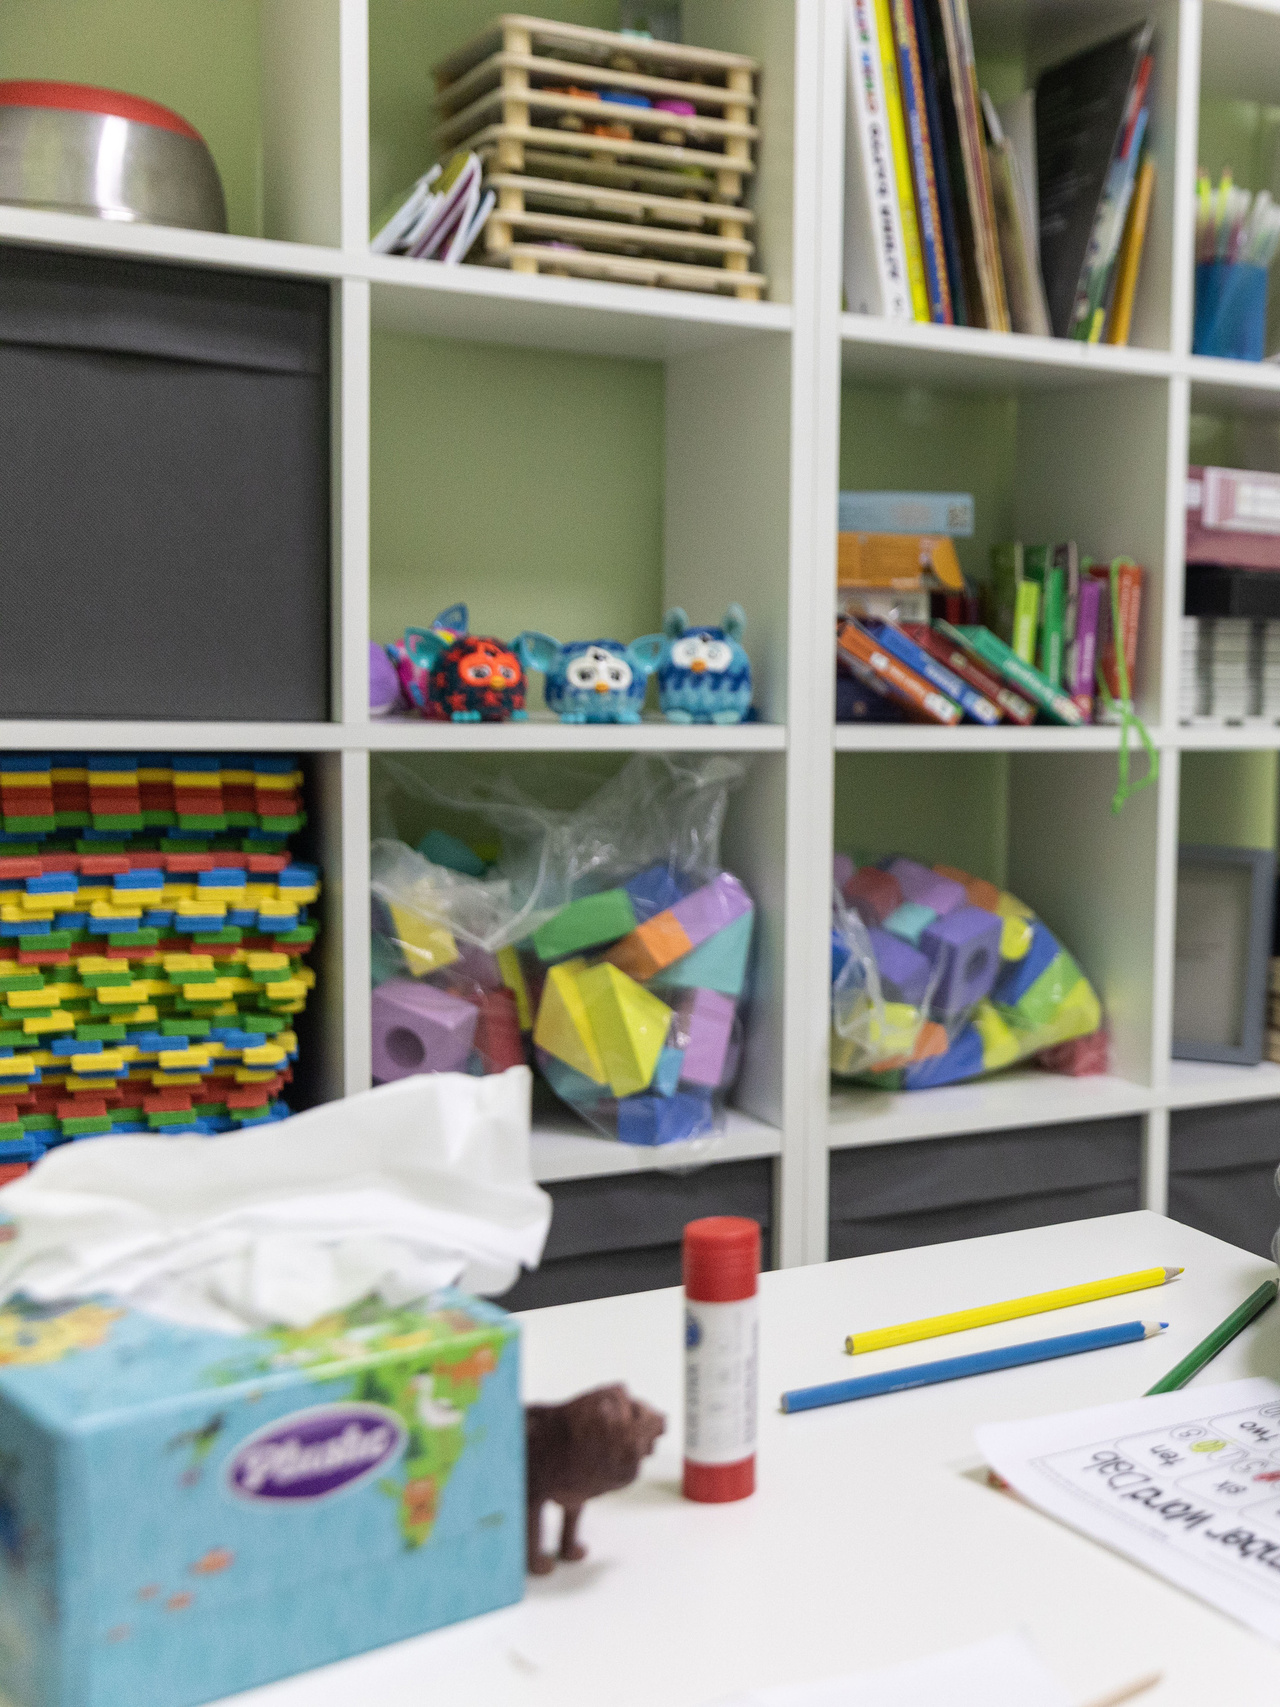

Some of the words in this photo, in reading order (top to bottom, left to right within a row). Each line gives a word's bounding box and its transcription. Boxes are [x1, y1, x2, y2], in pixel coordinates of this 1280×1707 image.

[1239, 1420, 1280, 1443] two
[1150, 1443, 1185, 1467] ten
[1083, 1450, 1152, 1489] Dab
[1214, 1477, 1248, 1494] six
[1120, 1487, 1214, 1530] Word
